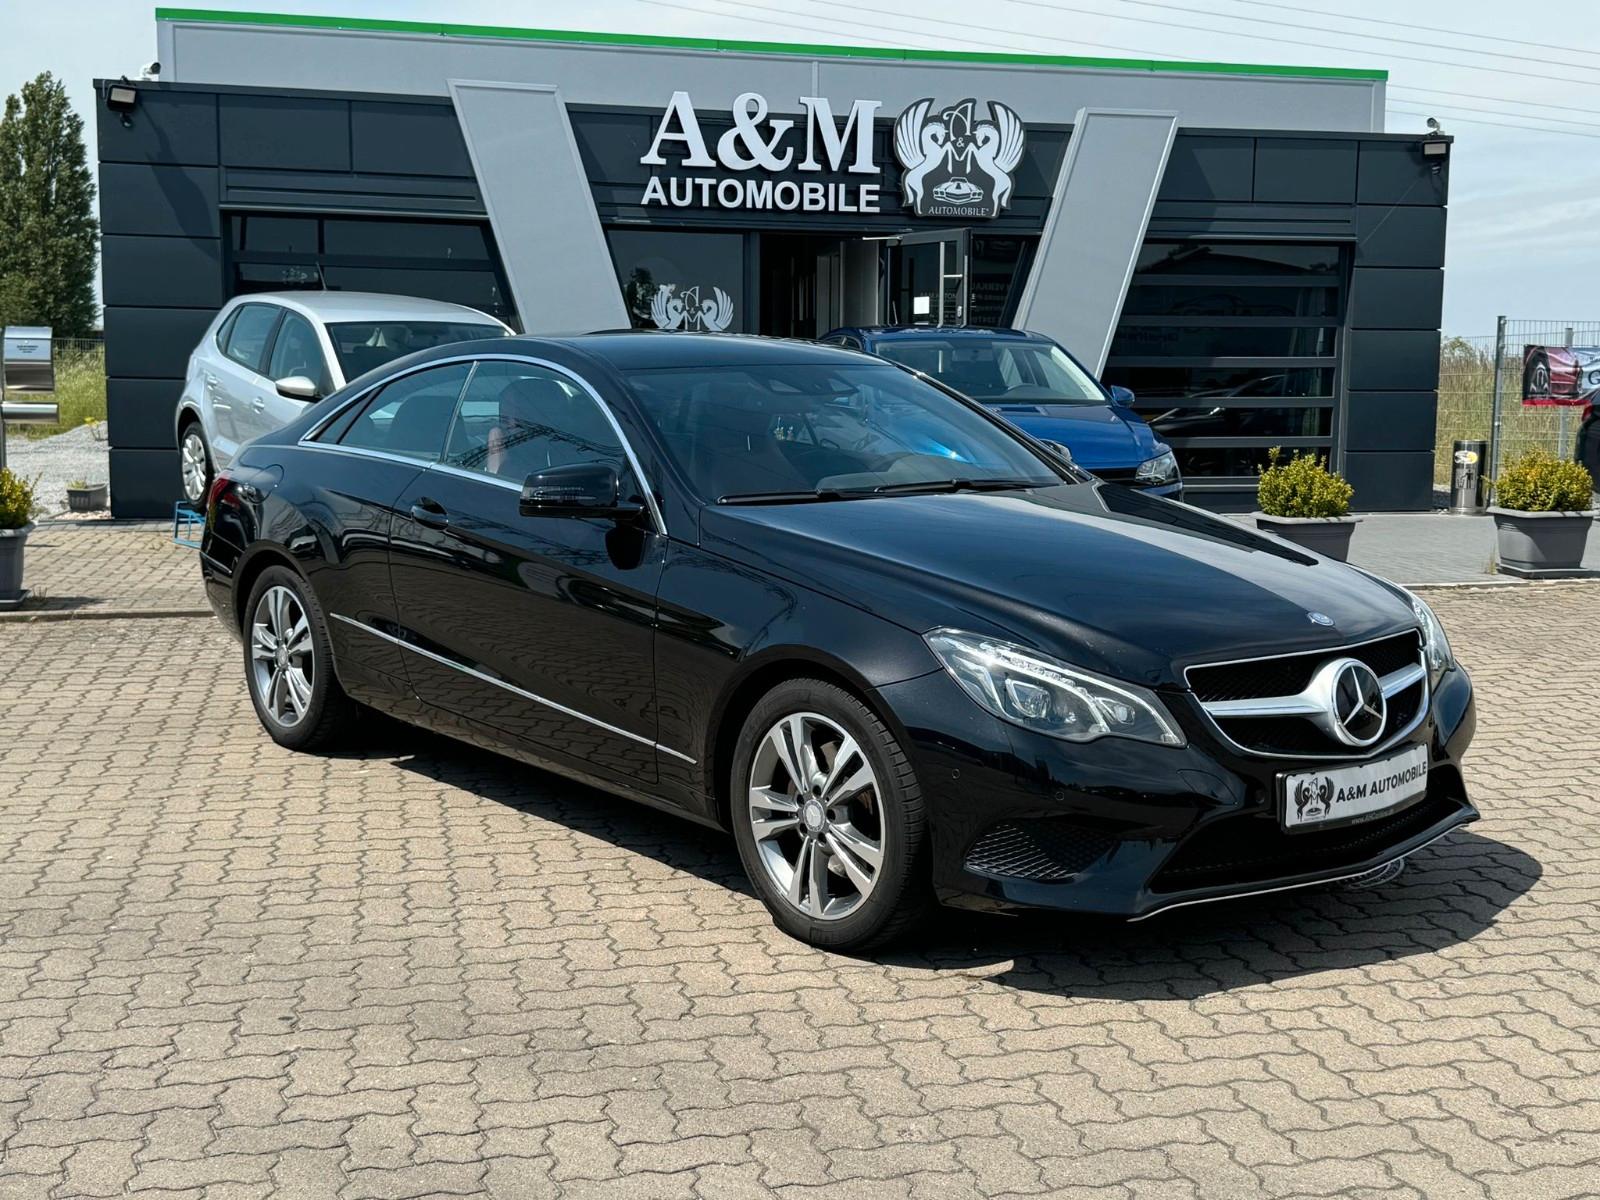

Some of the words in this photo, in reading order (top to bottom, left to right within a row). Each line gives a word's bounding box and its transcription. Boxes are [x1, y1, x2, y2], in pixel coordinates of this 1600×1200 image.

[640, 91, 882, 173] A&M
[641, 176, 881, 213] AUTOMOBILE
[1336, 783, 1367, 803] A&M
[1369, 761, 1427, 796] AUTOMOBILE
